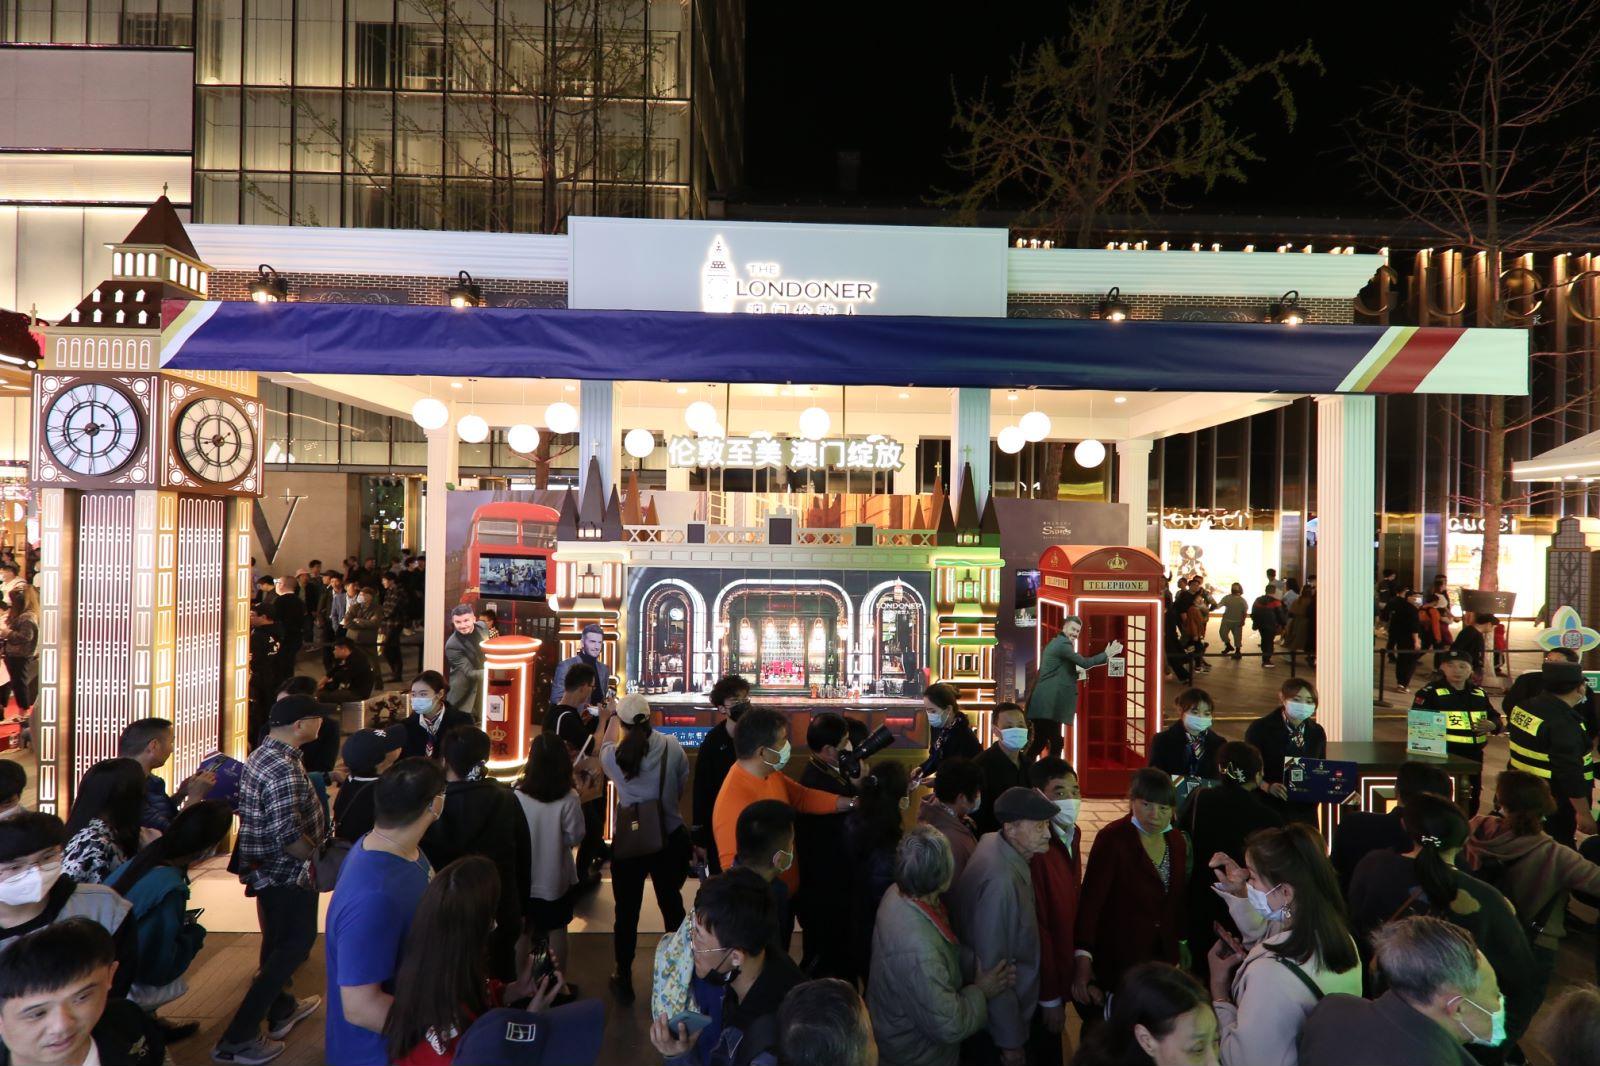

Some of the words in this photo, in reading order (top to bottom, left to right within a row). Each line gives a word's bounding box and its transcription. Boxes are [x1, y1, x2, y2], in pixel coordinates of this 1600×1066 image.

[750, 264, 777, 274] THE
[736, 281, 872, 299] LONDONER
[669, 438, 782, 467] 伦敦至美
[791, 439, 903, 468] 澳门绽放
[1089, 581, 1144, 590] TELEPHONE
